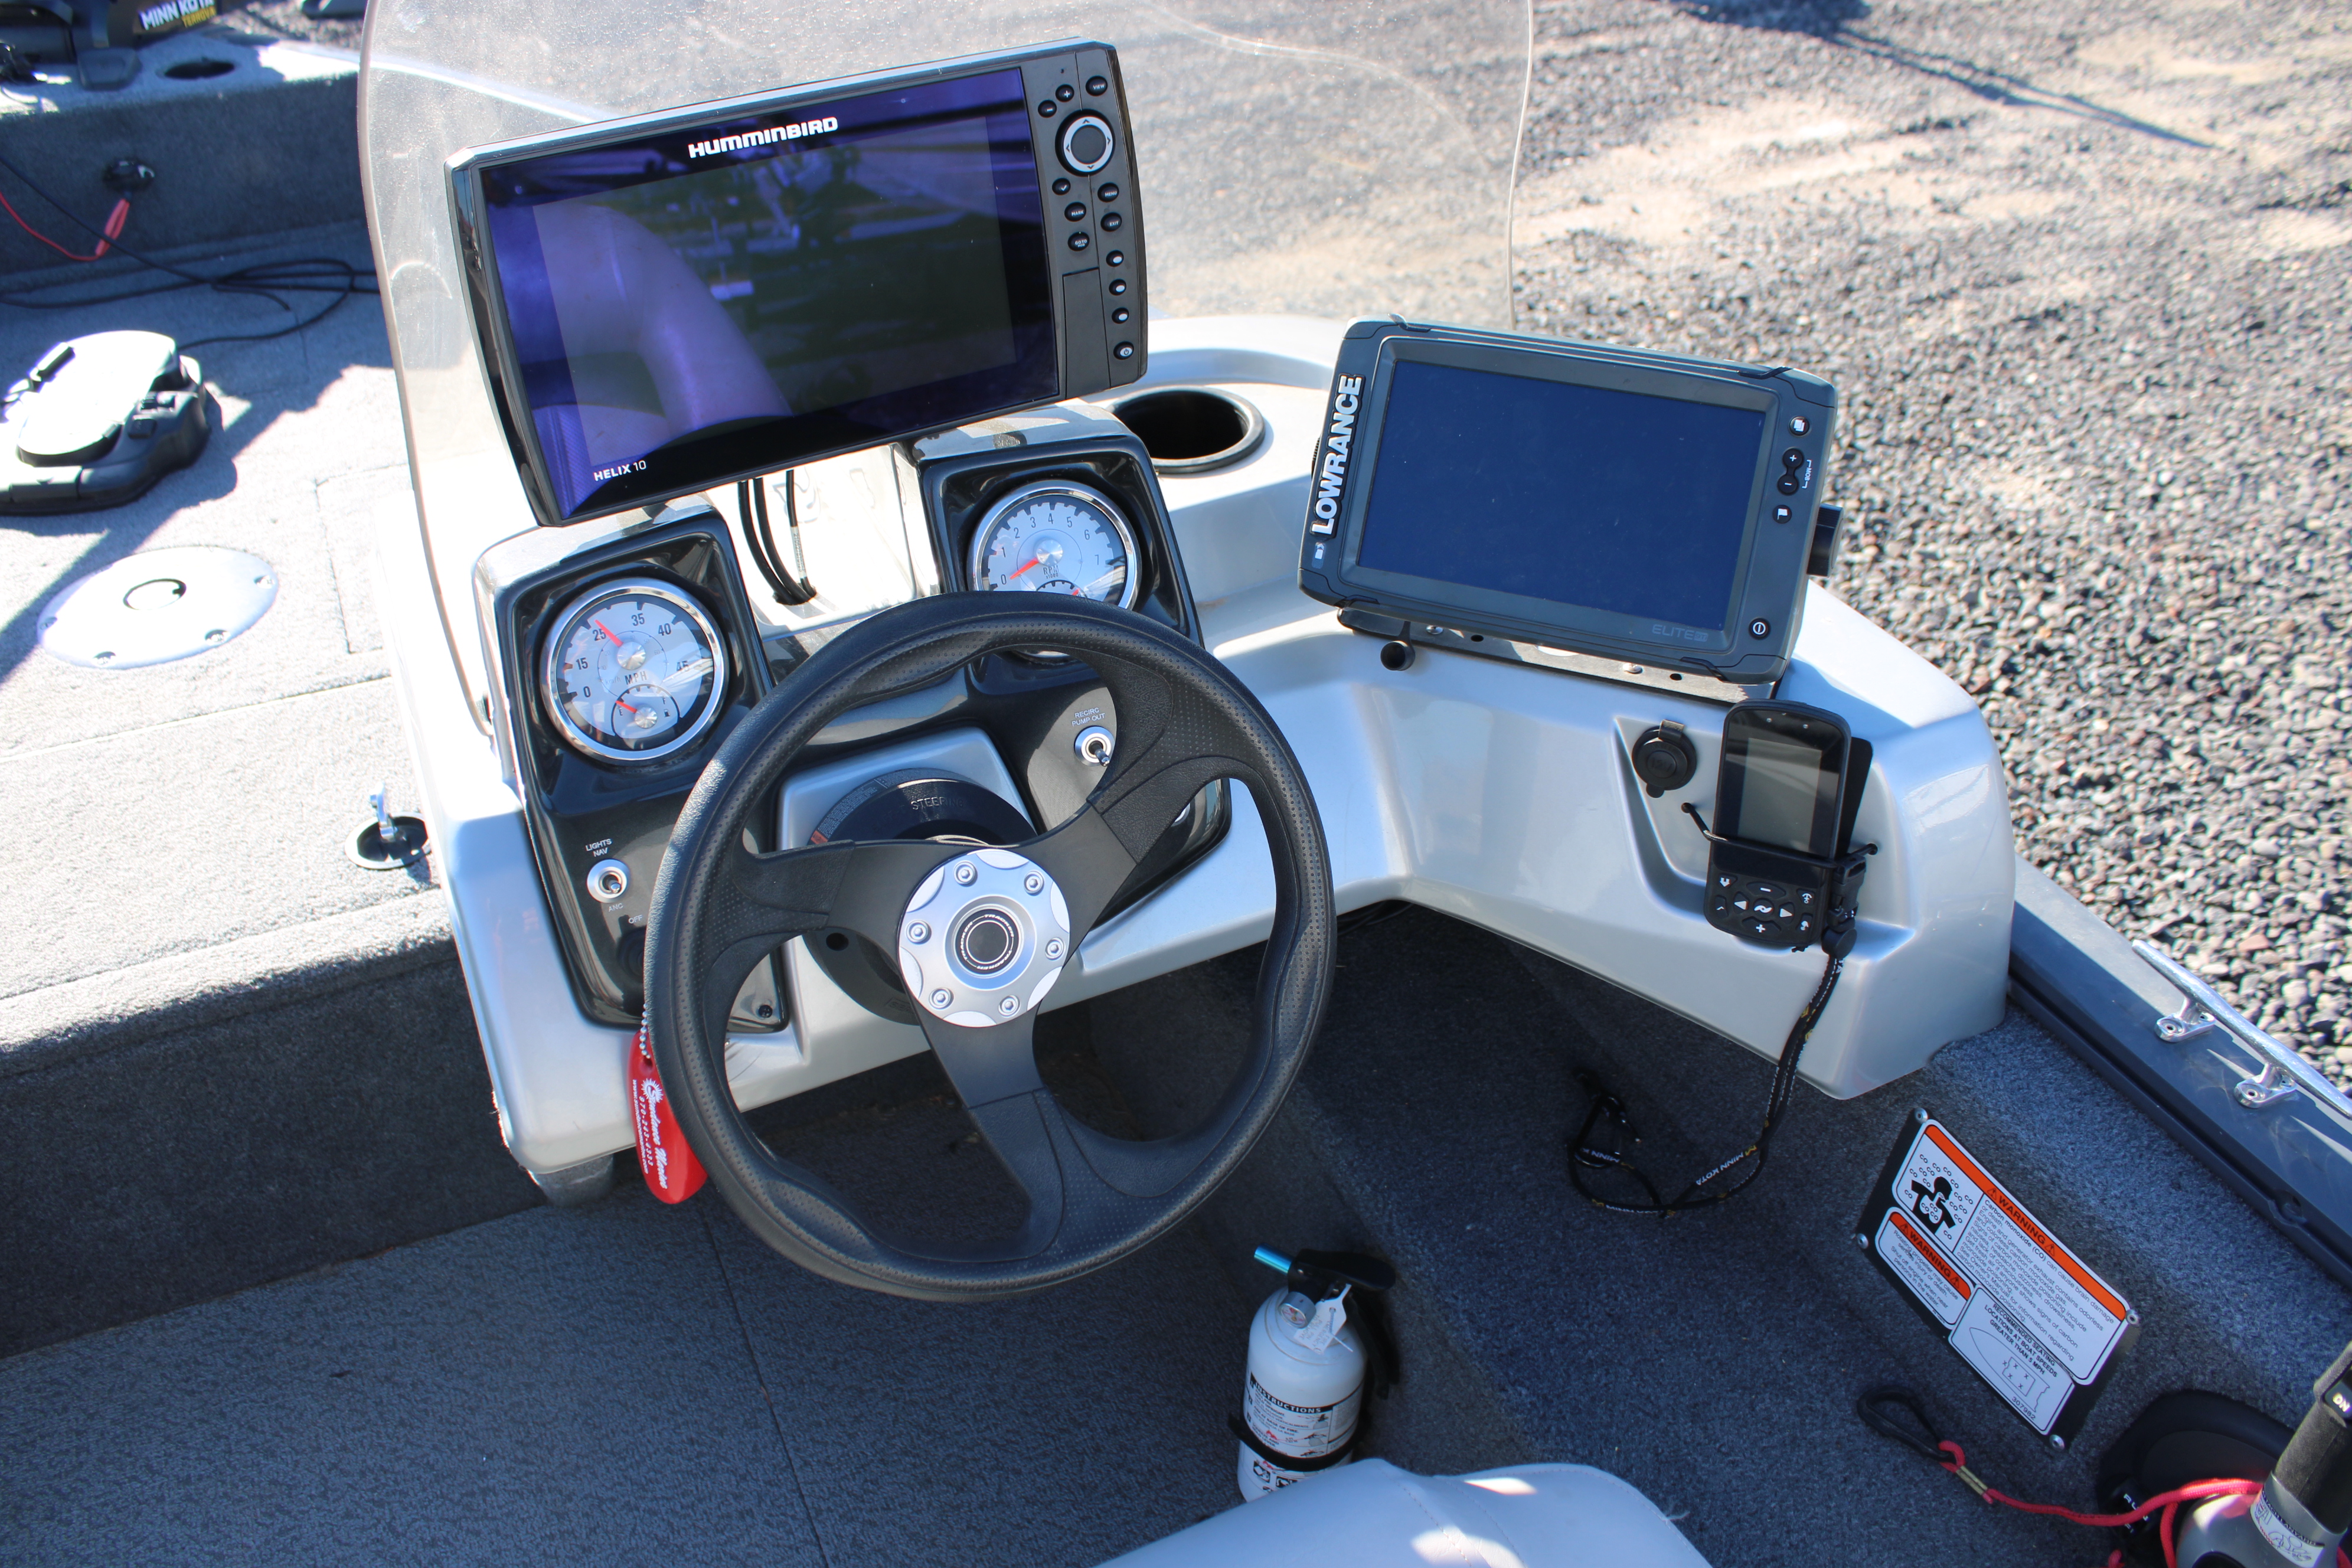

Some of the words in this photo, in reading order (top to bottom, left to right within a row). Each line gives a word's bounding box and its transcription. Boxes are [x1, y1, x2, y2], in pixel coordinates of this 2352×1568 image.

[138, 1, 180, 30] MINN
[688, 116, 838, 159] HUMMINBIRD
[1311, 375, 1362, 535] LOWRANCE
[593, 464, 631, 481] HELIX
[633, 460, 646, 471] 10
[1030, 517, 1036, 528] 3
[1048, 512, 1054, 525] 4
[1066, 516, 1073, 528] 5
[1013, 527, 1020, 539] 2
[1084, 529, 1090, 540] 6
[1001, 547, 1006, 558] 1
[1095, 554, 1100, 566] 7
[1043, 565, 1059, 575] RPM
[1001, 574, 1007, 585] 0
[631, 613, 645, 626] 35
[592, 628, 606, 641] 25
[658, 623, 672, 636] 40
[1652, 623, 1695, 641] ELITE
[576, 658, 589, 670] 15
[676, 661, 690, 672] 45
[625, 671, 647, 685] MPH
[583, 686, 591, 698] 0
[1074, 707, 1100, 718] RECIRC
[1072, 717, 1090, 727] PUMP
[1092, 713, 1105, 721] OUT
[910, 796, 964, 811] STEERING
[585, 838, 612, 851] LIGHTS
[593, 847, 608, 857] NAV
[609, 903, 623, 912] ANC
[628, 914, 642, 924] OFF
[984, 914, 1014, 937] TRACKER
[1919, 1154, 1928, 1164] CO
[655, 1147, 668, 1190] Marine
[1909, 1168, 1917, 1178] CO
[1918, 1167, 1927, 1177] CO
[1926, 1166, 1935, 1176] CO
[1932, 1162, 1941, 1172] CO
[1942, 1167, 1952, 1177] CO
[1696, 1168, 1719, 1186] KOTA
[1922, 1178, 1931, 1188] CO
[1950, 1178, 1959, 1188] CO
[1904, 1189, 1913, 1199] CO
[1954, 1191, 1962, 1201] CO
[1964, 1194, 1973, 1205] CO
[1920, 1202, 1929, 1212] CO
[1929, 1203, 1938, 1213] CO
[1949, 1201, 1958, 1211] CO
[1958, 1204, 1967, 1214] CO
[1929, 1211, 1938, 1221] CO
[1954, 1213, 1962, 1223] CO
[1988, 1211, 2003, 1227] death.
[1999, 1196, 2045, 1244] WARNING
[1943, 1230, 1952, 1240] CO
[1910, 1231, 1951, 1277] WARNING
[1893, 1229, 1912, 1253] Rotating
[1910, 1251, 1933, 1273] propeller
[1932, 1272, 1943, 1285] may
[1943, 1283, 1958, 1299] cause
[1914, 1260, 1927, 1275] injury
[1962, 1241, 1987, 1267] monoxide
[1986, 1266, 2012, 1293] poisoning.
[1967, 1231, 1978, 1242] and
[1978, 1240, 1989, 1253] lack
[1995, 1259, 2033, 1298] consciousness.
[1975, 1216, 1987, 1227] and
[1986, 1226, 2009, 1250] colorless
[2009, 1249, 2028, 1268] carbon
[2028, 1267, 2055, 1294] monoxide
[2054, 1293, 2066, 1306] gas.
[1984, 1199, 2004, 1220] Carbon
[2004, 1220, 2031, 1247] monoxide
[2031, 1246, 2046, 1262] (CO)
[2046, 1260, 2057, 1272] can
[2057, 1270, 2075, 1288] cause
[2075, 1286, 2089, 1302] brain
[2090, 1301, 2114, 1324] damage
[1890, 1245, 1902, 1259] Shut
[1907, 1265, 1923, 1283] engine
[1923, 1282, 1936, 1297] when
[1936, 1296, 1948, 1308] near
[1893, 1257, 1912, 1278] persons
[1917, 1282, 1925, 1292] the
[1973, 1220, 1988, 1236] Signs
[1994, 1242, 2012, 1260] carbon
[2012, 1260, 2039, 1286] monoxide
[2038, 1285, 2066, 1313] poisoning
[2066, 1311, 2086, 1332] include
[1978, 1209, 1997, 1229] Engine
[1996, 1228, 2008, 1240] and
[2007, 1239, 2033, 1264] generator
[2033, 1264, 2054, 1285] exhaust
[2054, 1285, 2078, 1308] contains
[2079, 1307, 2103, 1331] odorless
[1970, 1226, 1989, 1247] nausea,
[1990, 1245, 2016, 1274] headache,
[2017, 1273, 2042, 1299] dizziness,
[2044, 1298, 2075, 1331] drowsiness,
[1956, 1251, 1974, 1270] carbon
[1974, 1269, 2000, 1295] monoxide
[1999, 1295, 2026, 1322] poisoning.
[1965, 1235, 1975, 1247] Get
[1974, 1244, 1987, 1260] fresh
[1987, 1259, 1995, 1267] air
[1999, 1270, 2018, 1291] anyone
[2018, 1290, 2036, 1308] shows
[2036, 1307, 2052, 1323] signs
[2058, 1328, 2078, 1348] carbon
[1959, 1245, 1970, 1257] See
[1970, 1256, 1990, 1278] Owner's
[1990, 1276, 2010, 1298] Manual
[2010, 1296, 2018, 1305] for
[2017, 1305, 2047, 1334] information
[2047, 1334, 2074, 1361] regarding
[1984, 1305, 2013, 1334] LOCATIONS
[2013, 1333, 2021, 1341] AT
[2020, 1340, 2036, 1356] BOAT
[2036, 1355, 2057, 1377] SPEEDS
[1992, 1304, 2032, 1343] RECOMMENDED
[2032, 1341, 2055, 1366] SEATING
[1990, 1319, 2014, 1344] GREATER
[2014, 1342, 2028, 1358] THAN
[2032, 1361, 2044, 1374] MPH
[1255, 1382, 1321, 1413] INSTRUCTIONS
[2333, 1393, 2350, 1412] DN
[2011, 1396, 2036, 1420] 307982
